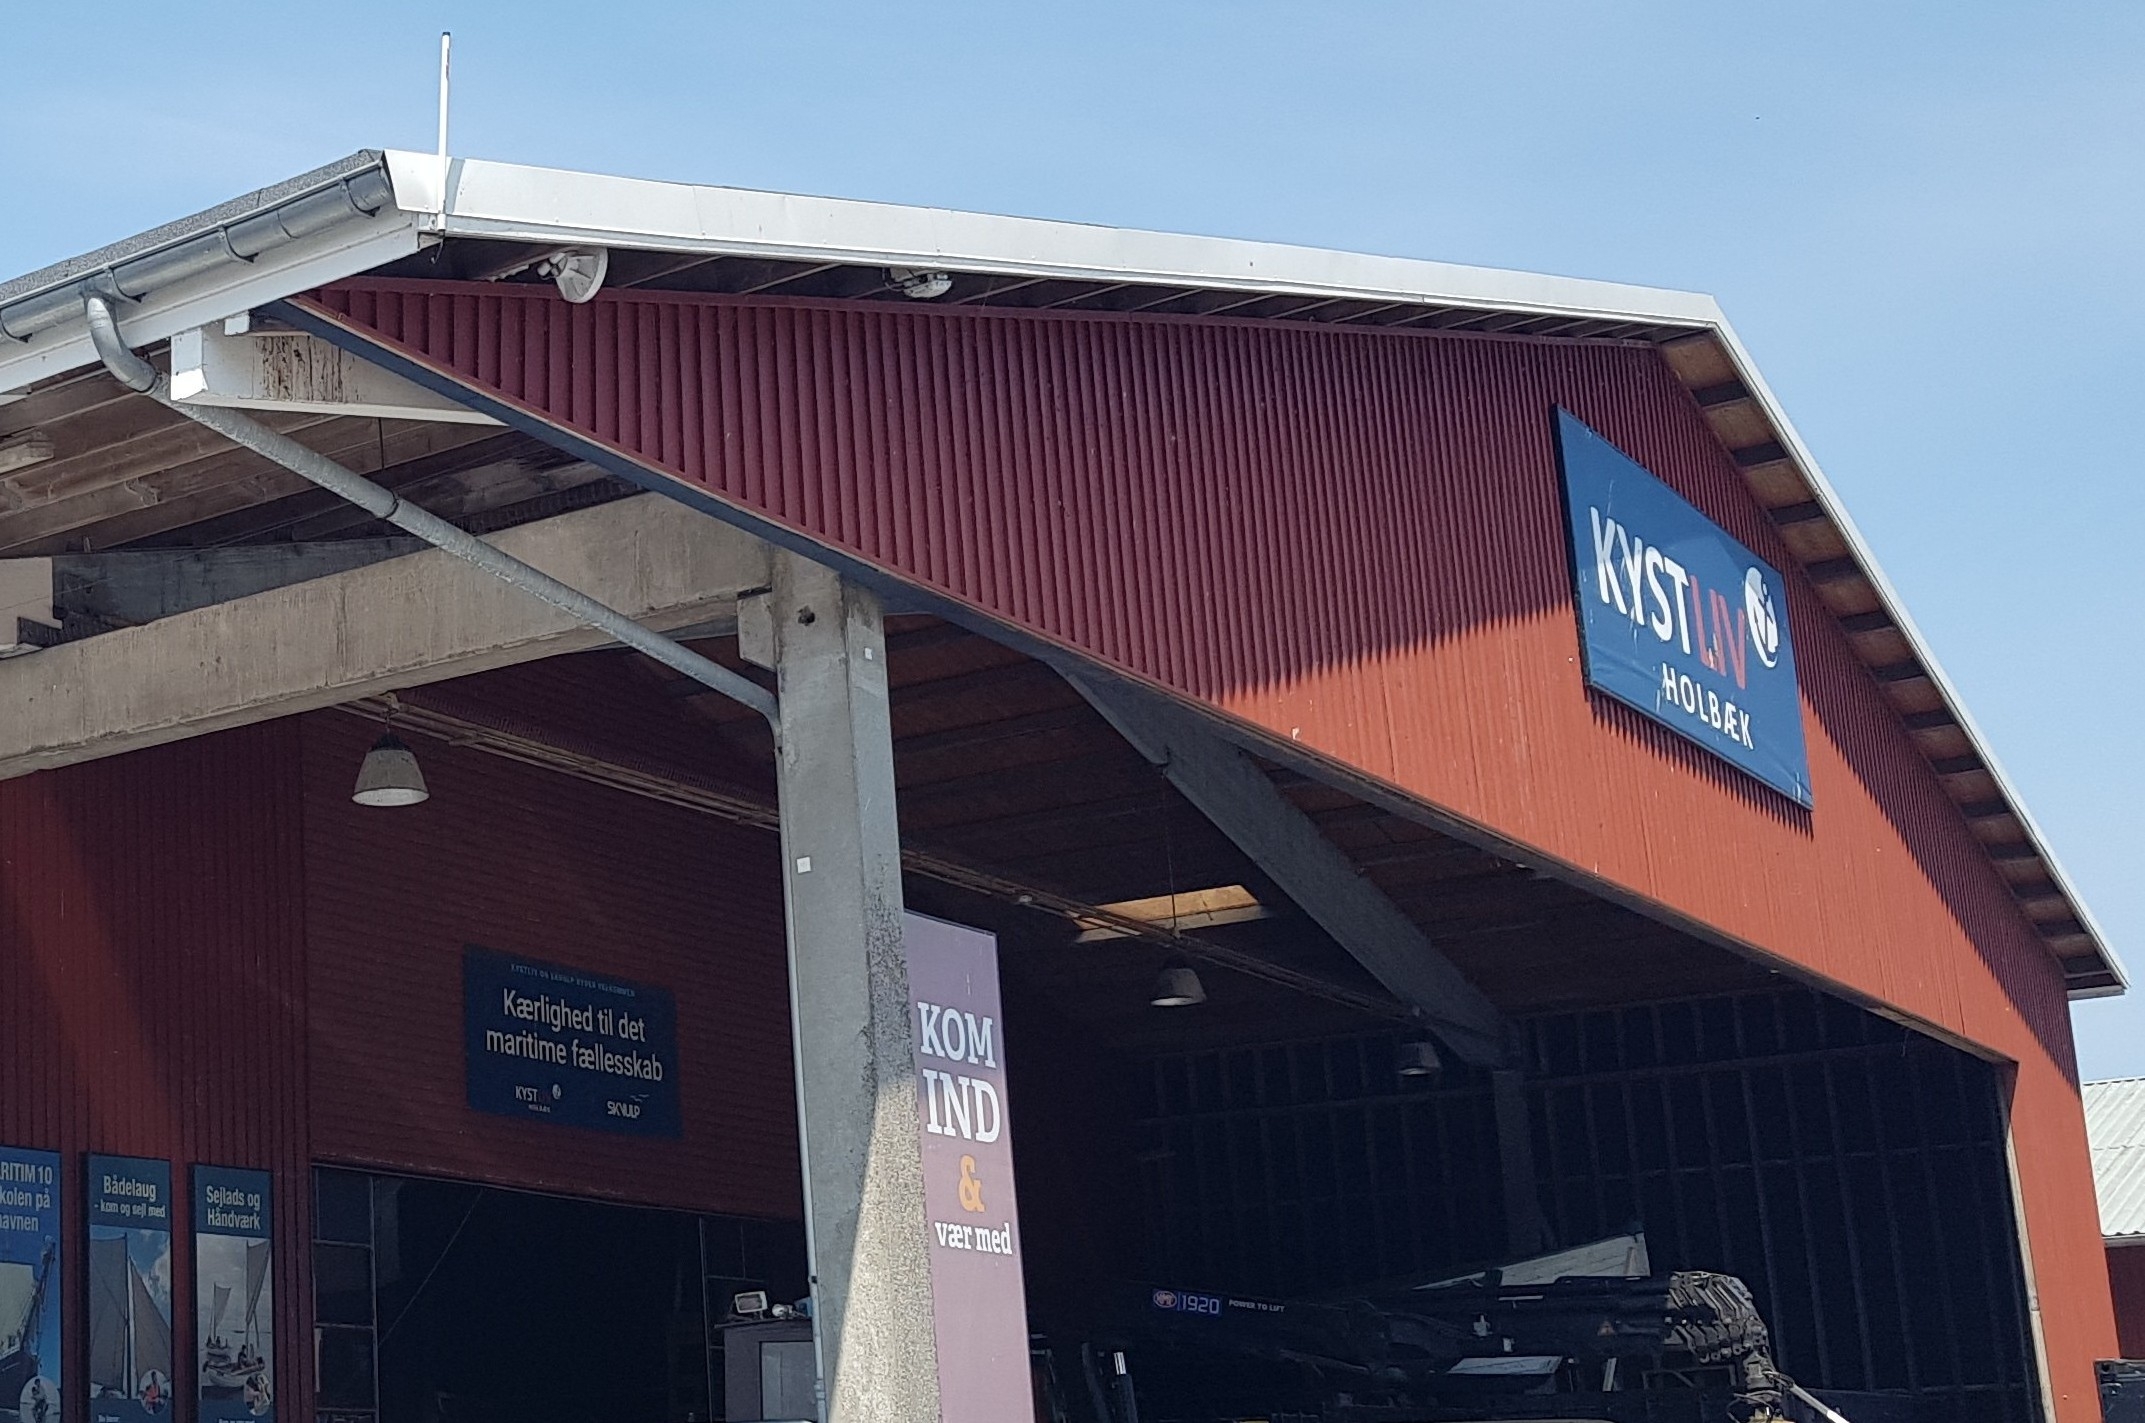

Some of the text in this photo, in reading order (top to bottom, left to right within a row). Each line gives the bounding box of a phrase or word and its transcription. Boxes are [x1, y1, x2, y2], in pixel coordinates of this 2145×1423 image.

[1590, 506, 1746, 690] KYSTLIV
[1662, 662, 1754, 750] HOLBÆK
[503, 987, 646, 1042] Kærlighed til det
[917, 1001, 996, 1069] KOM
[486, 1029, 663, 1081] maritime fællesskab
[923, 1068, 1001, 1143] IND
[0, 1161, 53, 1185] RITIM 10
[103, 1175, 156, 1202] Bådelaug
[958, 1154, 985, 1213] &
[36, 1188, 51, 1212] på
[100, 1198, 119, 1213] kom
[120, 1204, 131, 1217] og
[206, 1185, 261, 1211] Sejlads og
[206, 1208, 261, 1231] Håndværk
[934, 1221, 1013, 1255] vær med
[1182, 1294, 1220, 1314] 1920
[1229, 1299, 1255, 1309] POWER
[1257, 1302, 1268, 1310] TO
